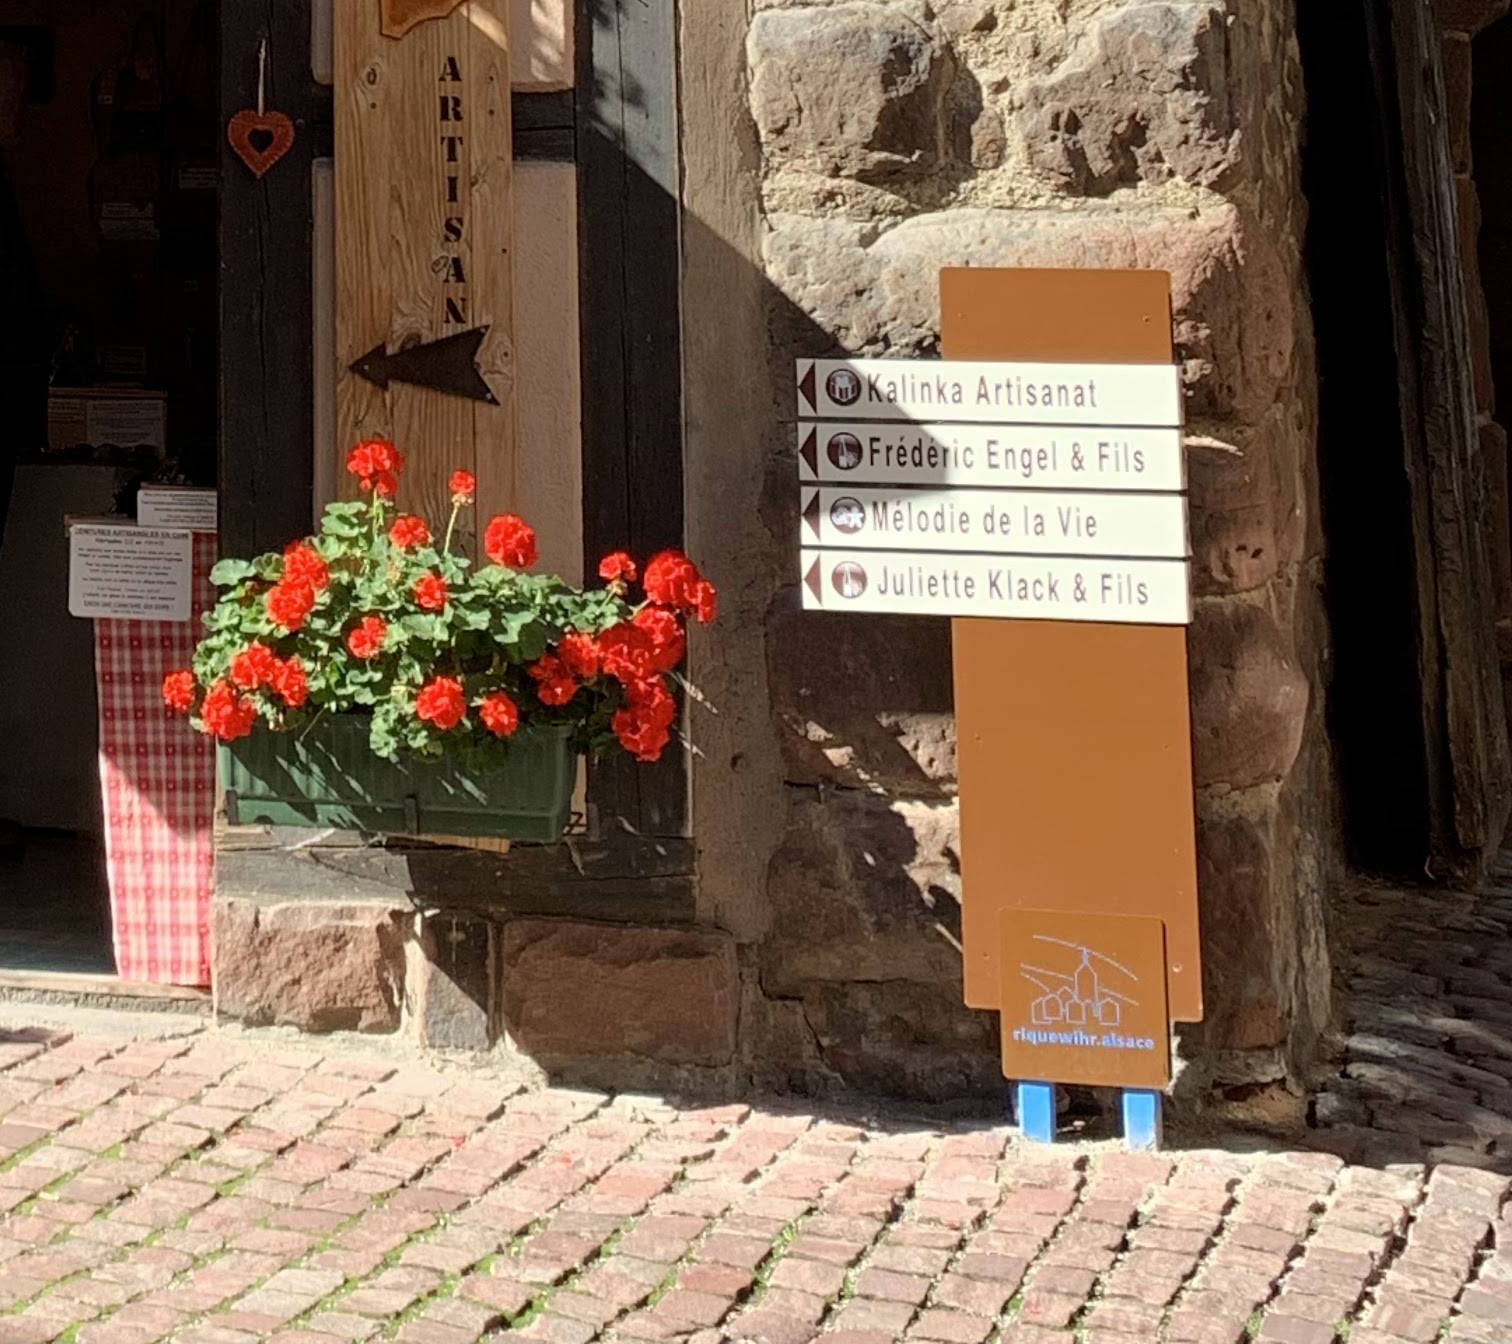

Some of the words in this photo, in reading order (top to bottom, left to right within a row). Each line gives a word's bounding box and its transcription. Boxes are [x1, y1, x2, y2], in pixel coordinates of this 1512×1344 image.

[437, 55, 467, 326] ARTISAN
[867, 372, 963, 405] Kalinka
[976, 375, 1097, 408] Artisanat
[869, 435, 975, 469] Frédéric
[987, 439, 1057, 478] Engel
[1070, 442, 1085, 472] &
[1098, 441, 1145, 473] Fils
[872, 499, 970, 534] Mélodie
[983, 504, 1011, 535] de
[1024, 505, 1045, 536] la
[1057, 506, 1098, 538] Vie
[878, 565, 976, 600] Juliette
[988, 568, 1060, 602] Klack
[1073, 572, 1087, 603] &
[1101, 573, 1149, 606] Fils
[1012, 1027, 1155, 1051] riquewihr.alsace
